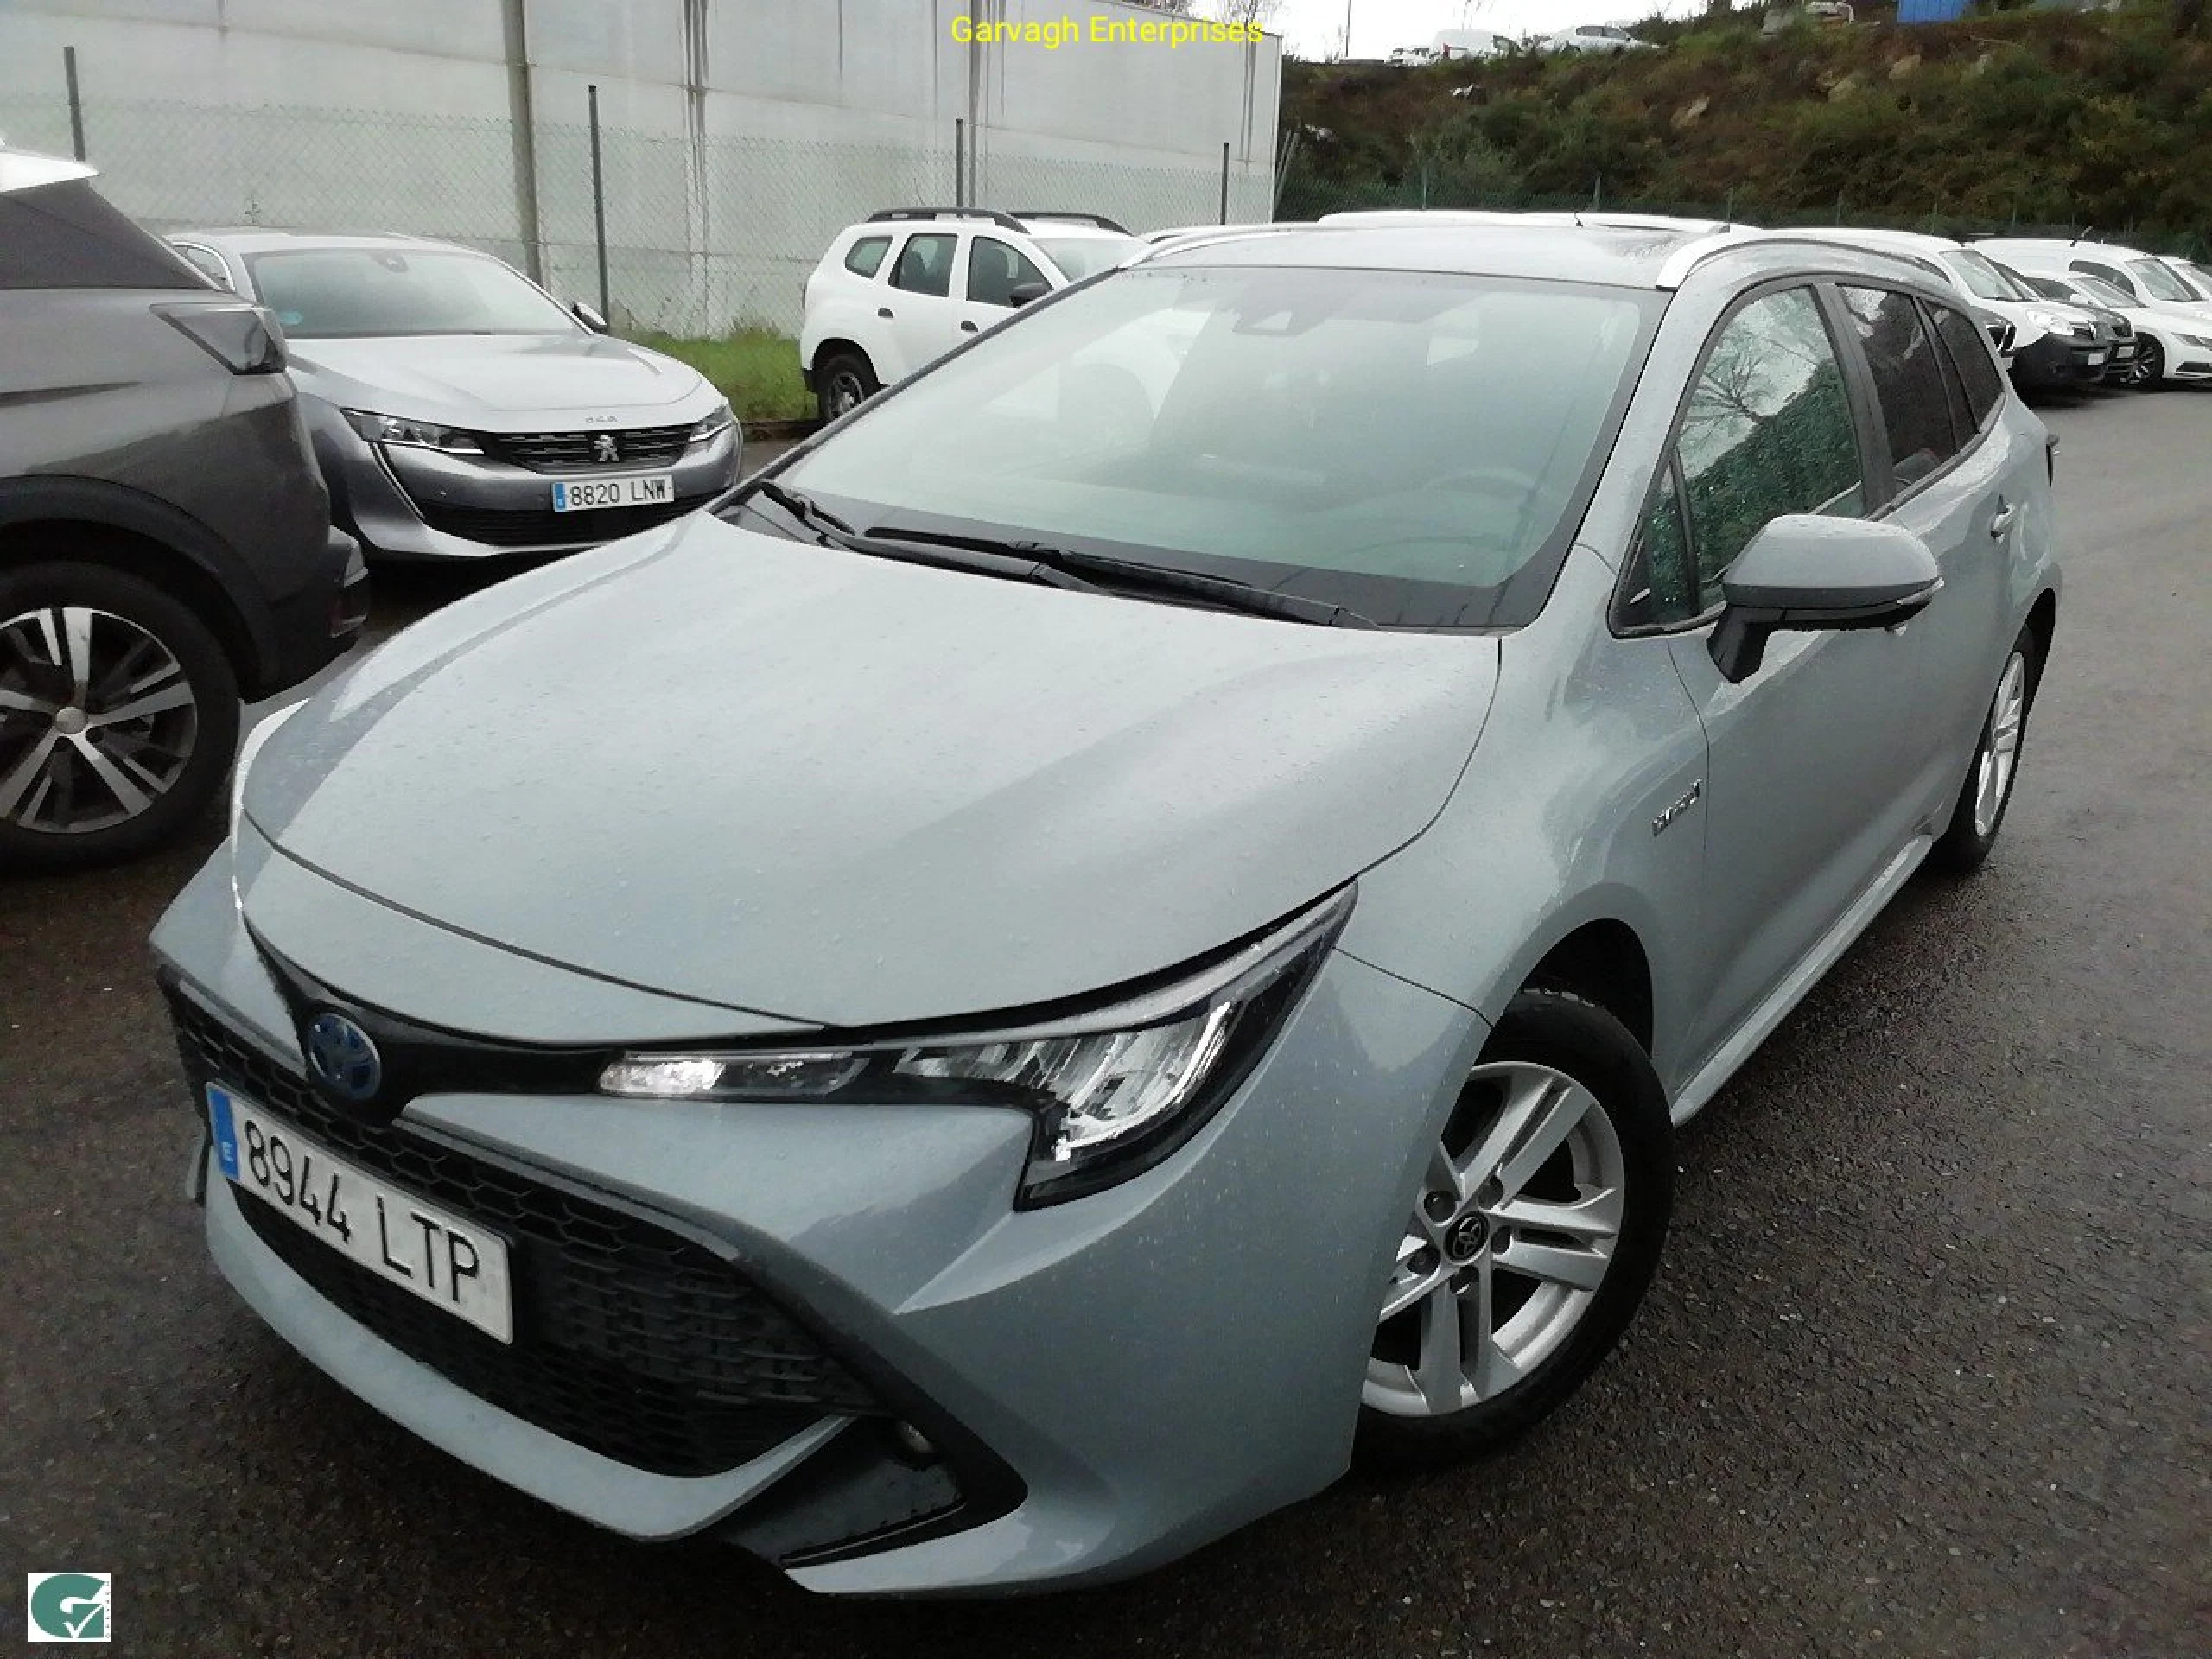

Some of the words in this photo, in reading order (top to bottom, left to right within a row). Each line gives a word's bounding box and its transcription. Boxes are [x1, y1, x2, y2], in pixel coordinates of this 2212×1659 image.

[569, 483, 621, 507] 8820
[631, 480, 666, 501] LNW
[245, 1119, 351, 1243] 8944
[377, 1194, 480, 1302] LTP
